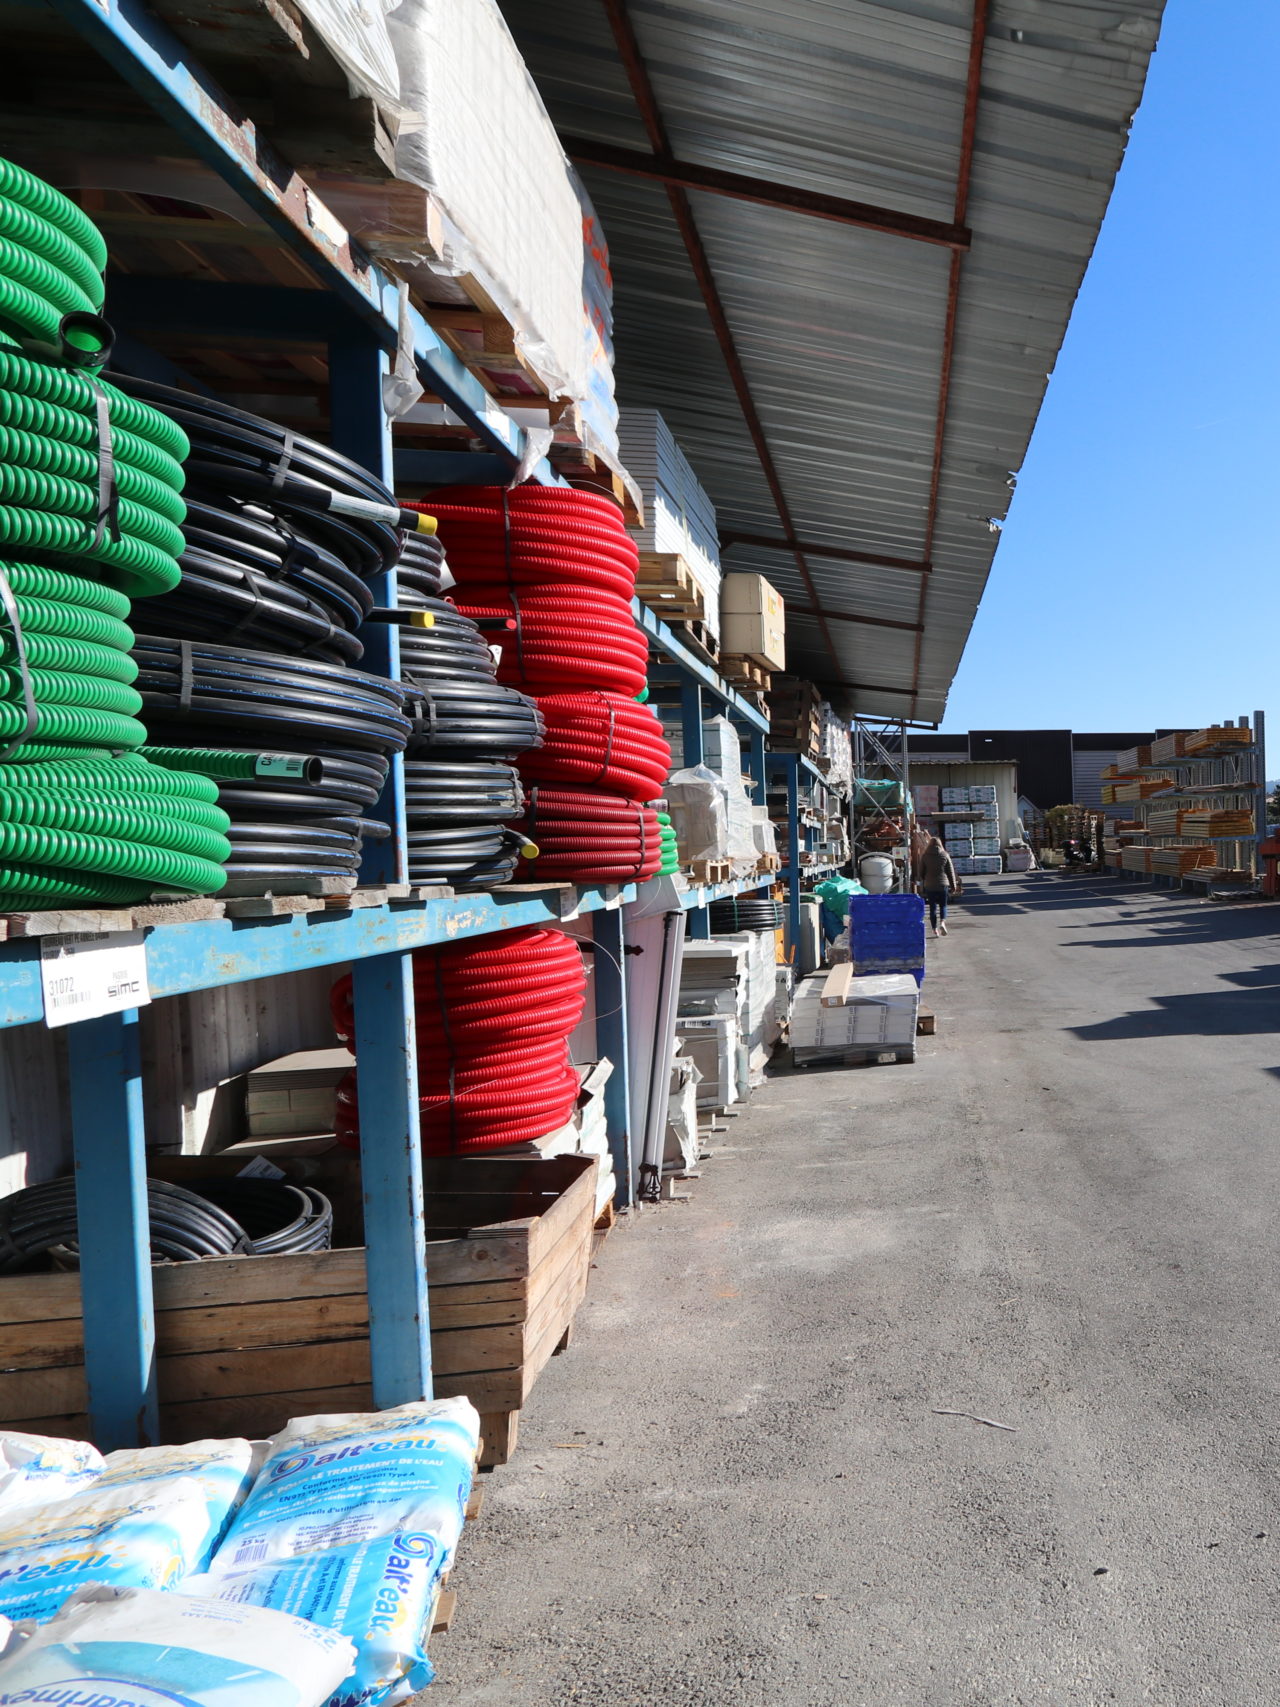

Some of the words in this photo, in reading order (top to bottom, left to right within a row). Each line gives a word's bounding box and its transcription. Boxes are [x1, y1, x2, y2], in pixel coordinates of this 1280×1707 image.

[49, 977, 74, 996] 31072
[311, 1472, 324, 1480] LE
[327, 1459, 397, 1477] TRAITEMENT
[414, 1458, 444, 1466] L'EAU
[302, 1476, 346, 1490] Conforme
